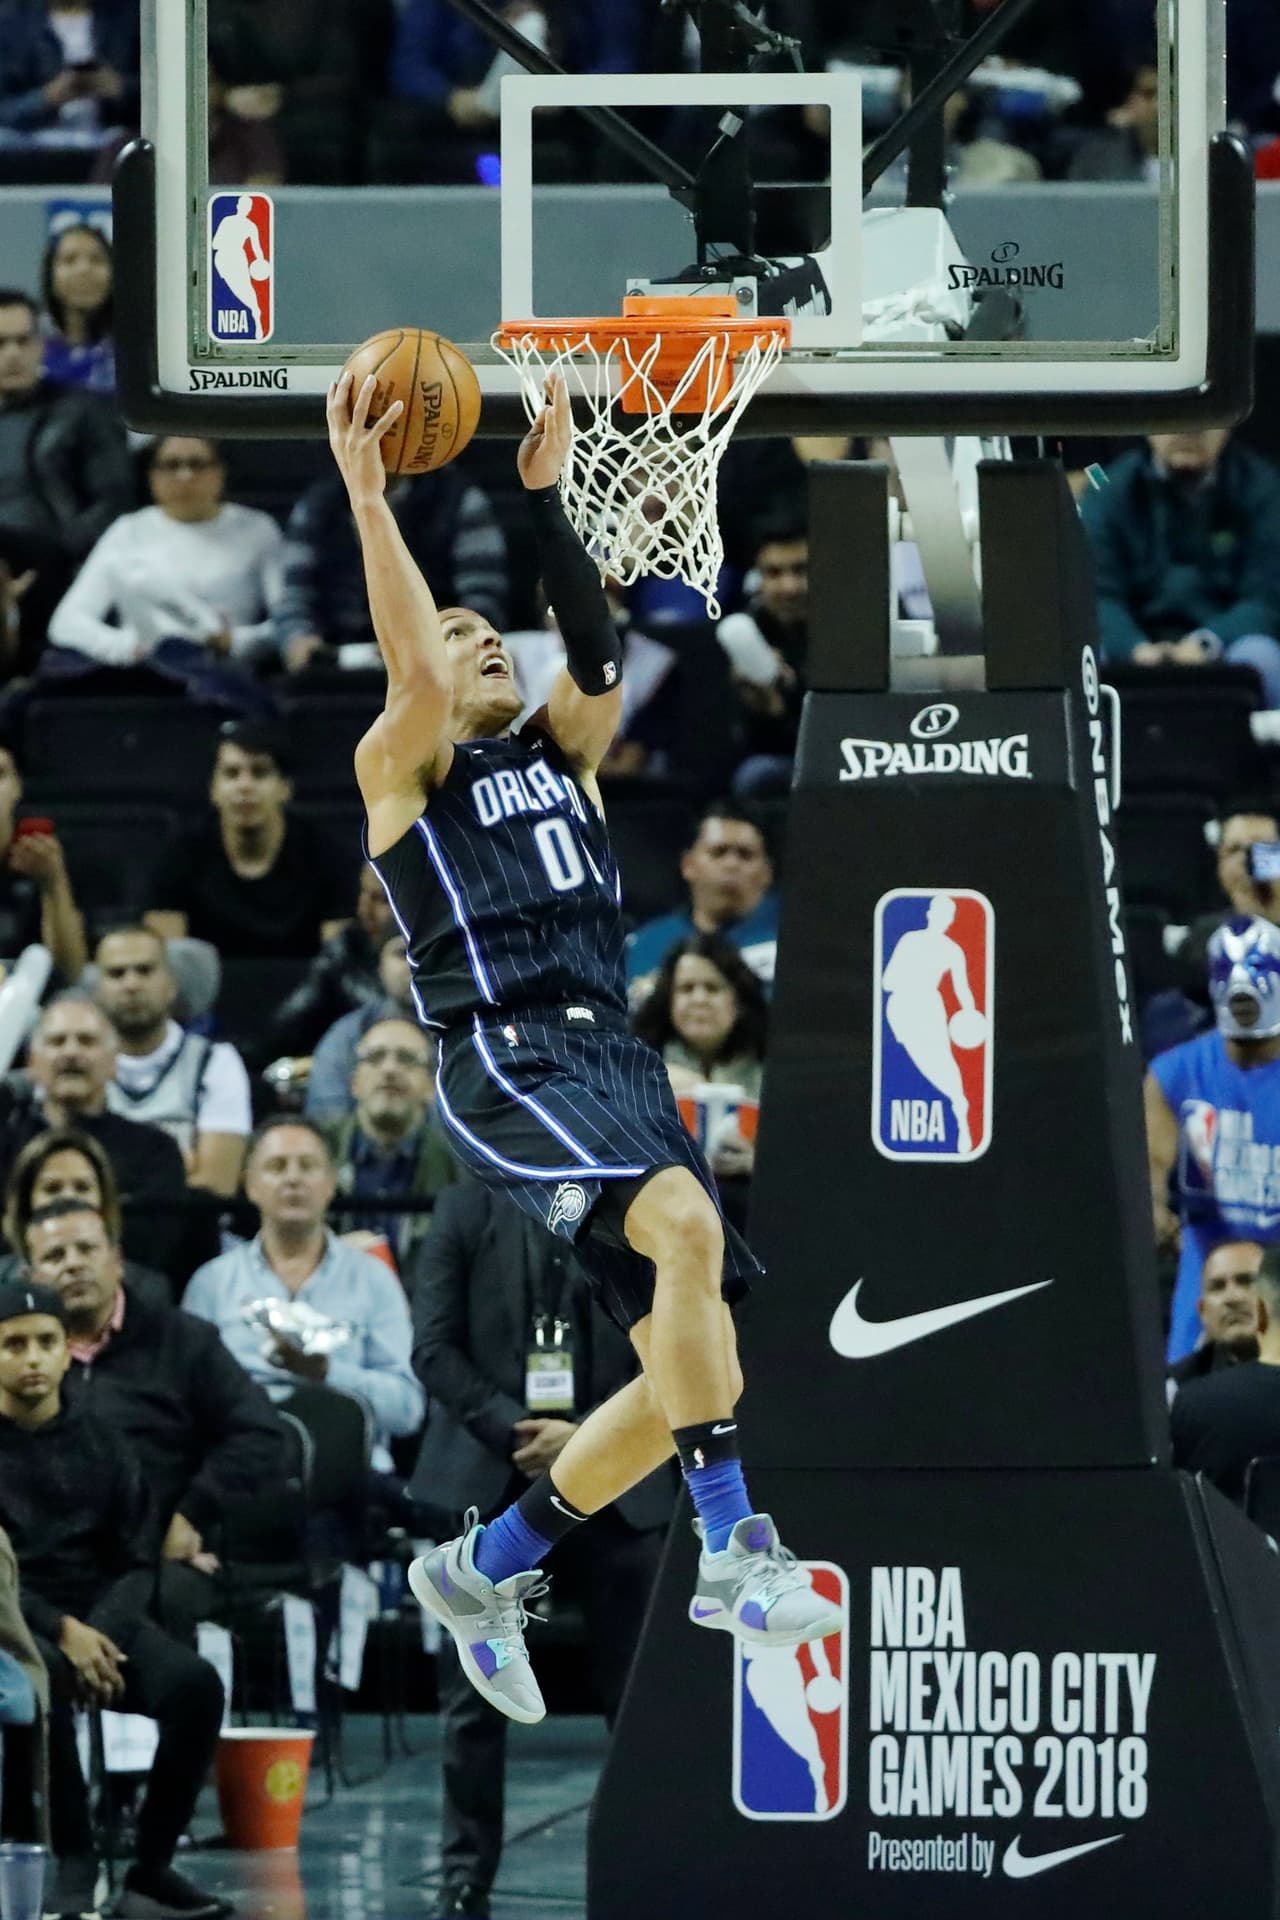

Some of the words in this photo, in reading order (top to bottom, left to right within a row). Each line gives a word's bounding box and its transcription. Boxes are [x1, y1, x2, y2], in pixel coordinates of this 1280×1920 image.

[948, 263, 1064, 290] SPALDING
[217, 309, 249, 333] NBA
[189, 368, 288, 391] SPALDING
[407, 381, 443, 469] SPALDING
[839, 734, 1030, 781] SPALDING
[534, 817, 585, 892] 0
[891, 1099, 946, 1142] NBA
[870, 1566, 967, 1649] NBA
[869, 1650, 1041, 1734] MEXICO
[1050, 1652, 1158, 1734] CITY
[869, 1734, 1024, 1817] GAMES
[1033, 1735, 1149, 1819] 2018
[867, 1831, 968, 1871] Presented
[971, 1832, 995, 1878] by
